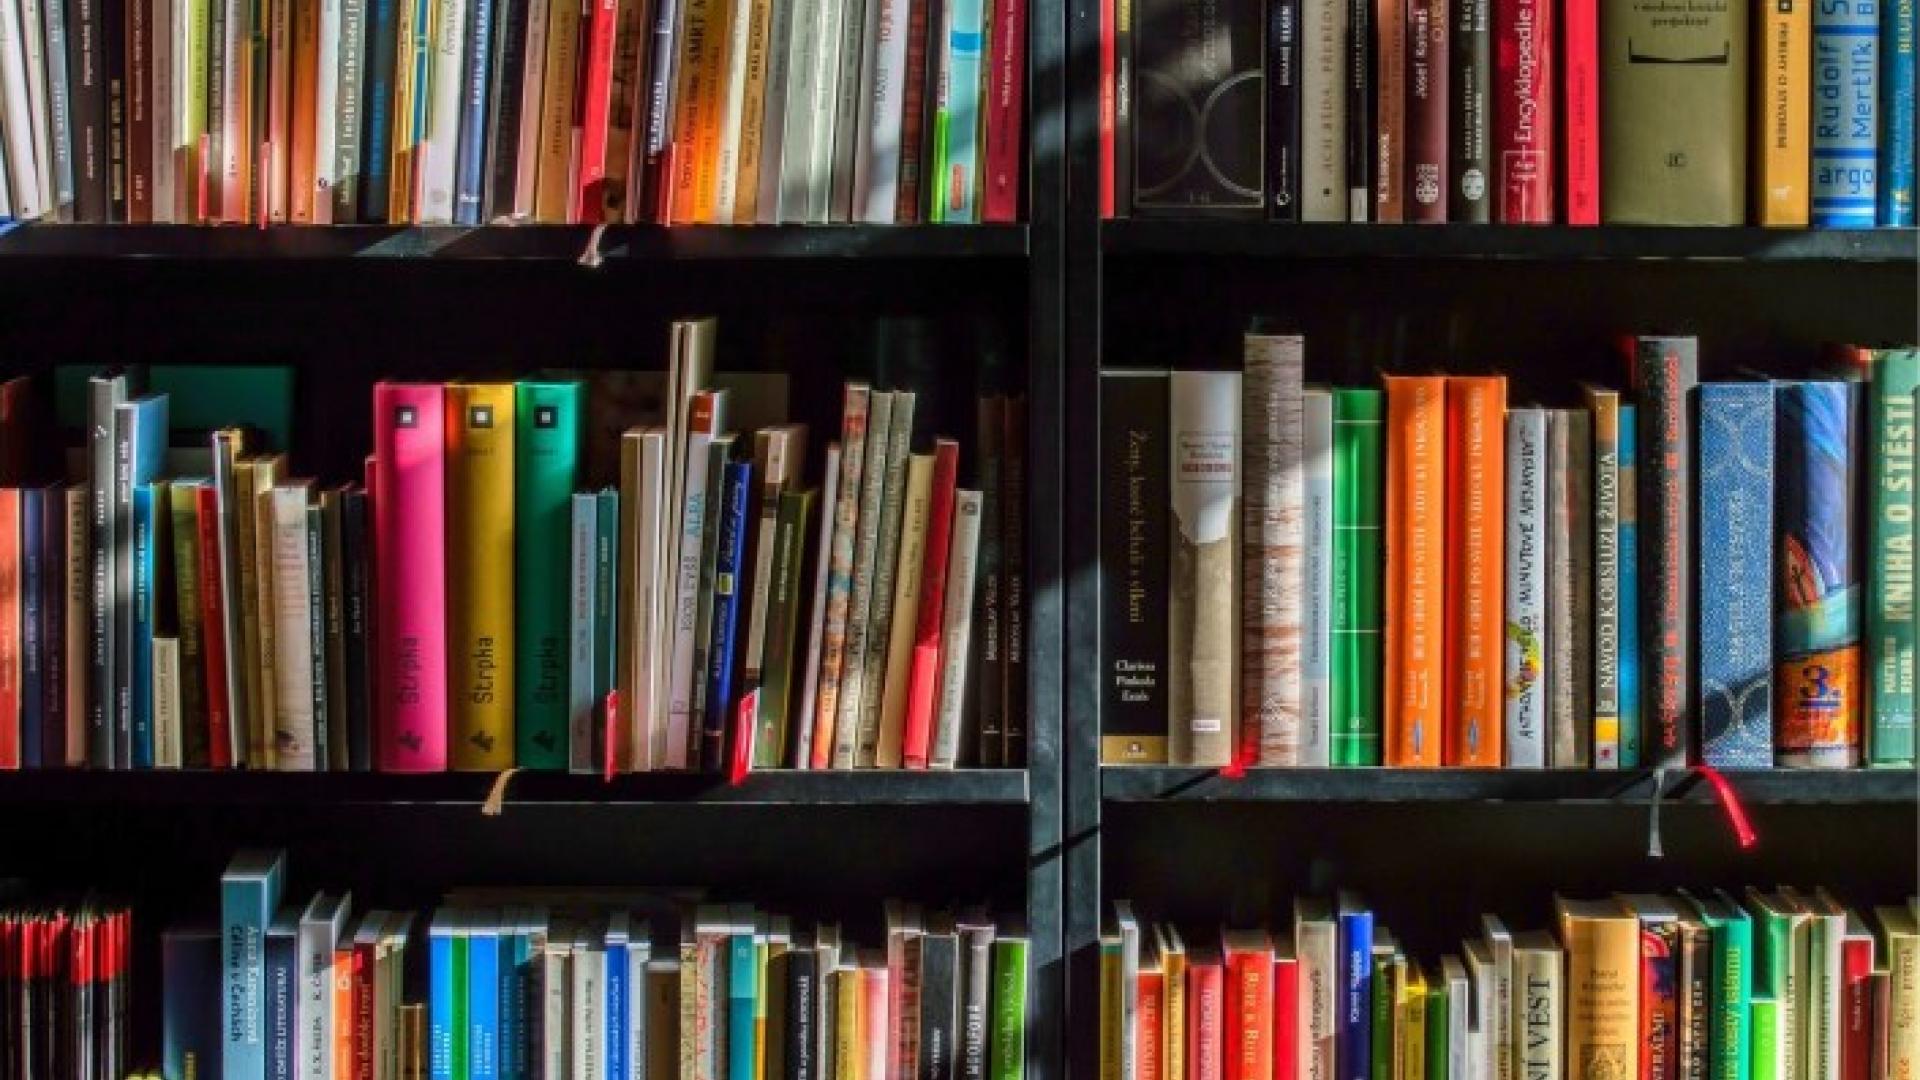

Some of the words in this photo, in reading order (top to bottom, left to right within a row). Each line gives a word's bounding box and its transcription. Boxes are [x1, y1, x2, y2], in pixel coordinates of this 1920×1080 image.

[1815, 40, 1841, 138] Rudolf
[1817, 166, 1874, 195] argo
[1884, 498, 1913, 522] O
[1884, 528, 1913, 621] KNIHA
